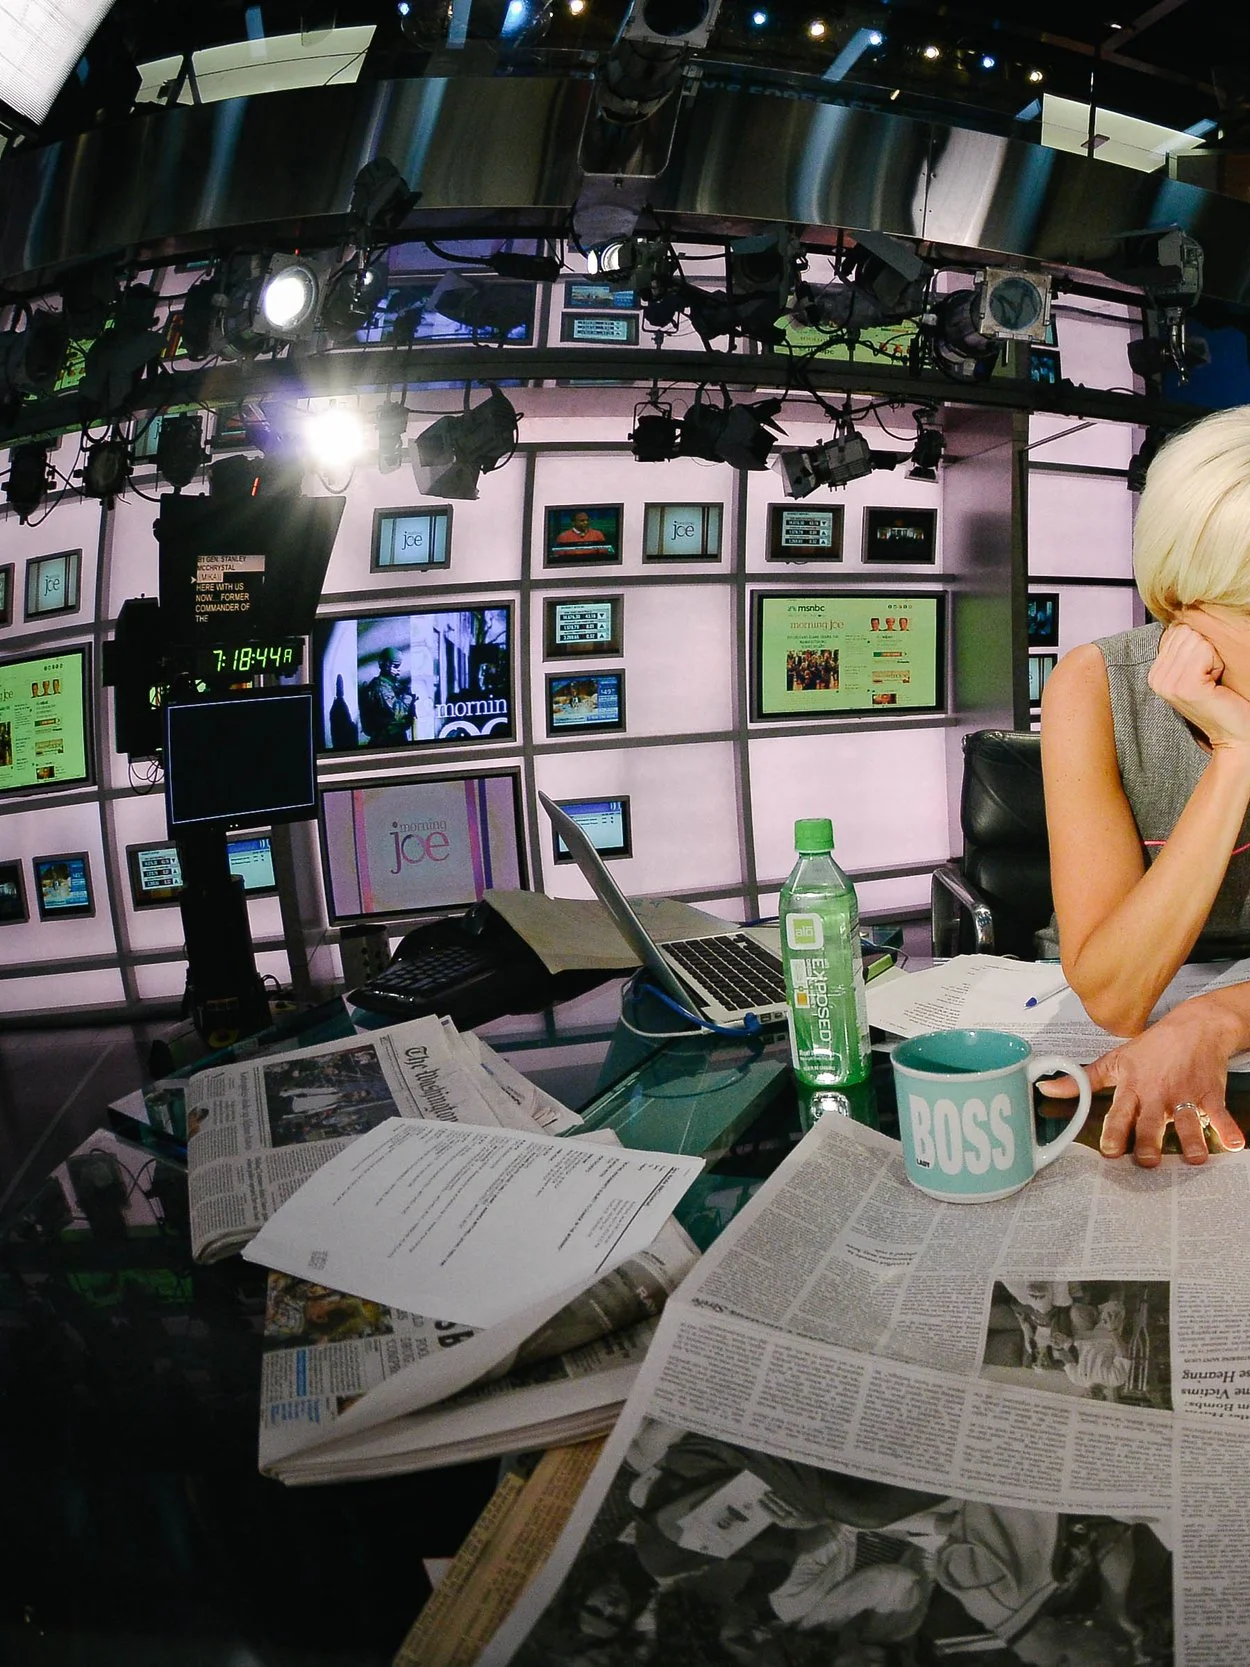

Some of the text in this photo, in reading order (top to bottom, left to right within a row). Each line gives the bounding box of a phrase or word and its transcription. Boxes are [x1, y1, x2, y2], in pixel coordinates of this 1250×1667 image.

[196, 582, 245, 591] HERE WITH US
[220, 593, 250, 601] FORMER
[195, 603, 251, 612] COMMANDER OF
[797, 604, 826, 613] msnbc
[195, 614, 209, 623] THE
[389, 820, 451, 875] joe
[811, 957, 833, 1043] EXPOSED
[404, 1045, 431, 1074] The
[909, 1093, 1016, 1175] BOSS
[1181, 1369, 1236, 1384] Hearing
[1181, 1387, 1230, 1400] Victims
